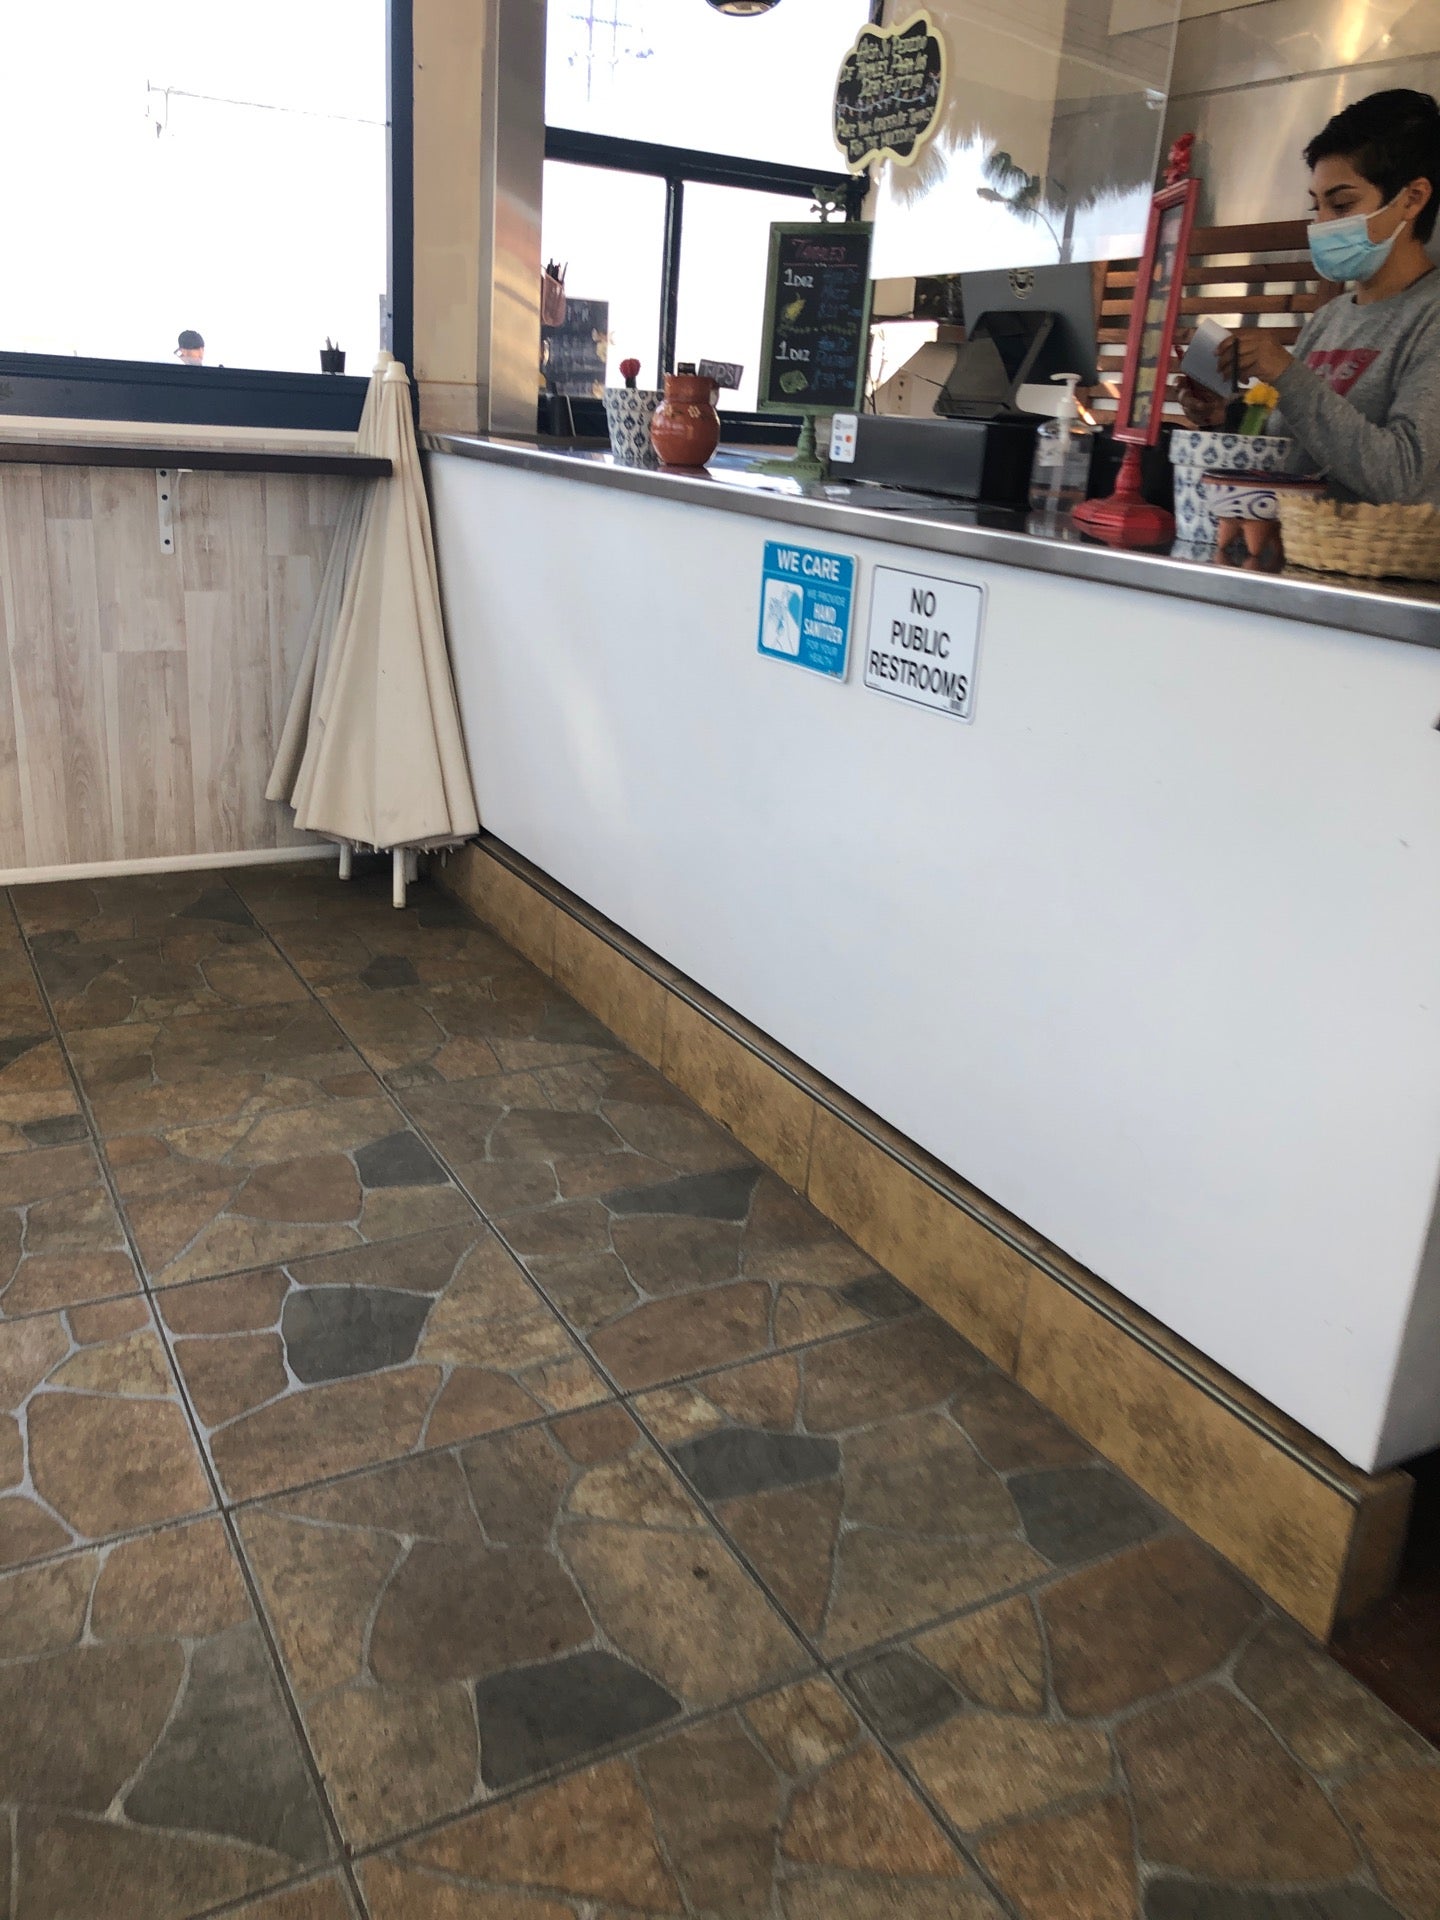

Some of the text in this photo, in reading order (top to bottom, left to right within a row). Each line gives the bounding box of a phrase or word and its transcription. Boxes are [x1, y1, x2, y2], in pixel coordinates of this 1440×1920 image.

[777, 548, 841, 582] WE CARE
[813, 602, 837, 625] HAND
[910, 587, 937, 618] NO
[802, 617, 844, 646] SANITIZER
[891, 620, 951, 659] PUBLIC
[869, 649, 968, 701] RESTROOMS
